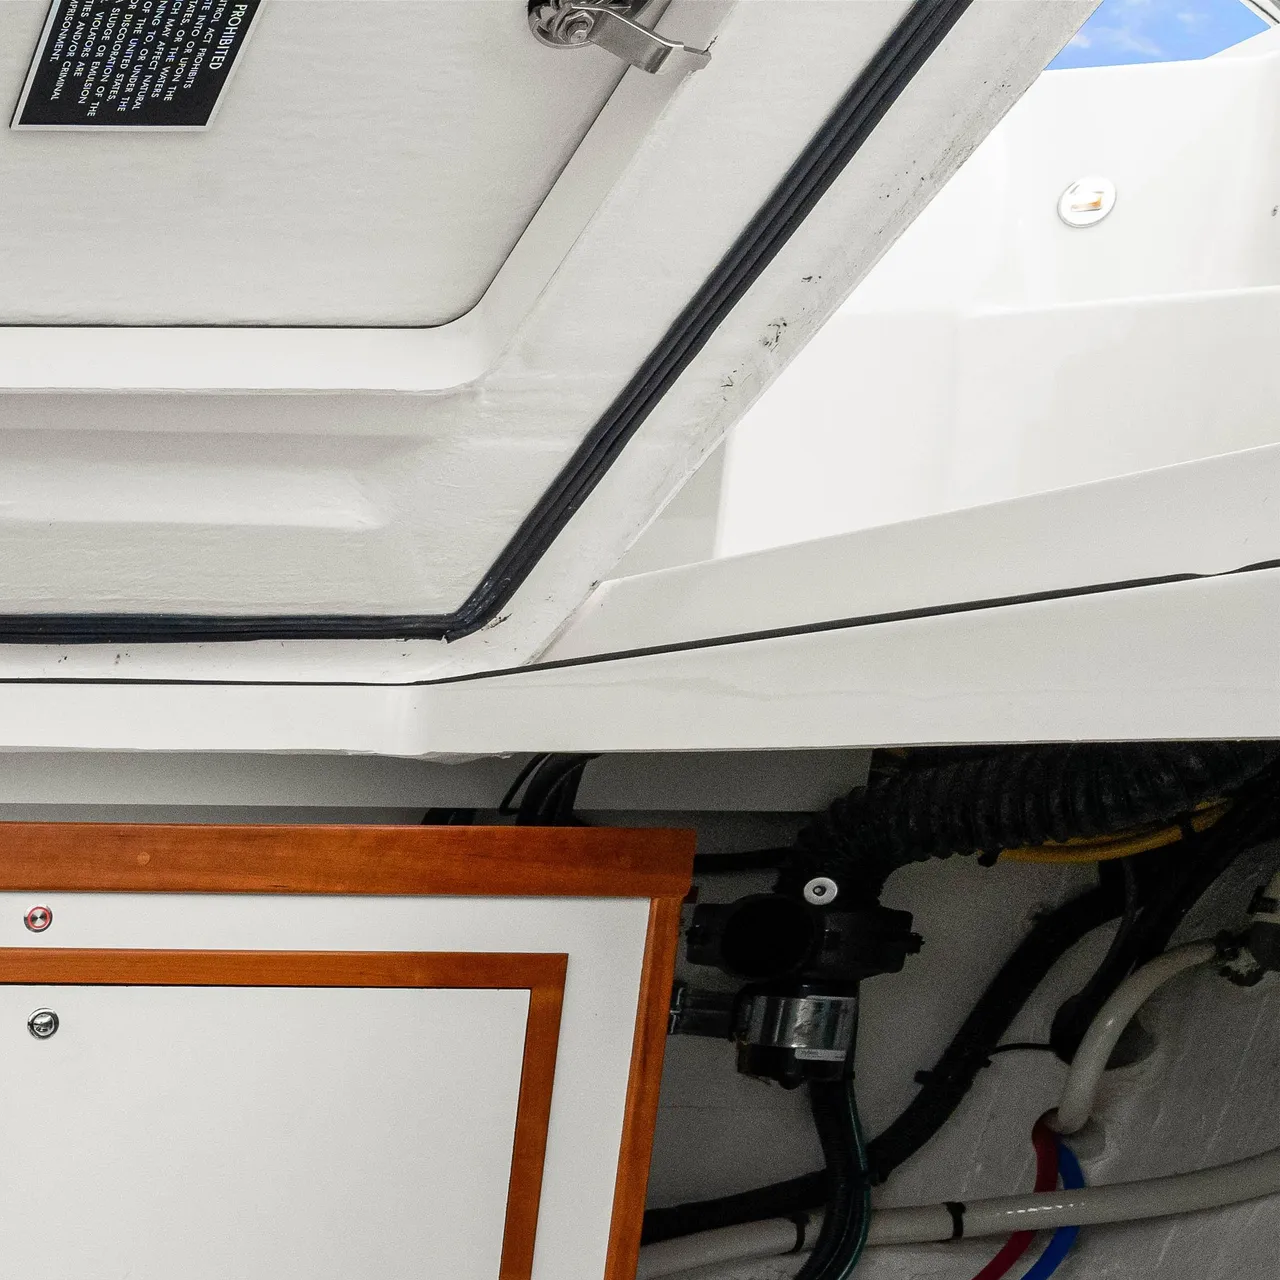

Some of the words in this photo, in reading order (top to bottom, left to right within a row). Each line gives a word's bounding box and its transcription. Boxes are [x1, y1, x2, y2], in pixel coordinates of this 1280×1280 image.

[141, 1, 153, 14] OF
[80, 11, 105, 58] VIOLATORS
[101, 7, 120, 41] SLUDGE
[132, 17, 147, 34] THE
[161, 18, 175, 38] MAY
[191, 14, 207, 37] INTO
[202, 27, 215, 44] ACT
[65, 21, 86, 57] AND/OR
[173, 29, 185, 43] OR
[183, 40, 195, 54] OR
[209, 4, 248, 70] PROHIBITED
[94, 44, 106, 58] OR
[100, 14, 133, 82] DISCOLORATION
[120, 38, 139, 69] UNITED
[137, 48, 149, 61] OR
[148, 40, 166, 70] AFFECT
[165, 46, 179, 63] THE
[73, 61, 85, 77] ARE
[125, 64, 143, 93] UNDER
[171, 57, 189, 82] UPON
[183, 48, 207, 89] PROHIBITS
[50, 60, 71, 101] CRIMINAL
[78, 61, 100, 104] EMULSION
[95, 85, 105, 98] OF
[151, 66, 171, 98] WATERS
[116, 96, 130, 112] THE
[132, 75, 153, 111] NATURAL
[163, 85, 177, 101] THE
[86, 101, 100, 117] THE
